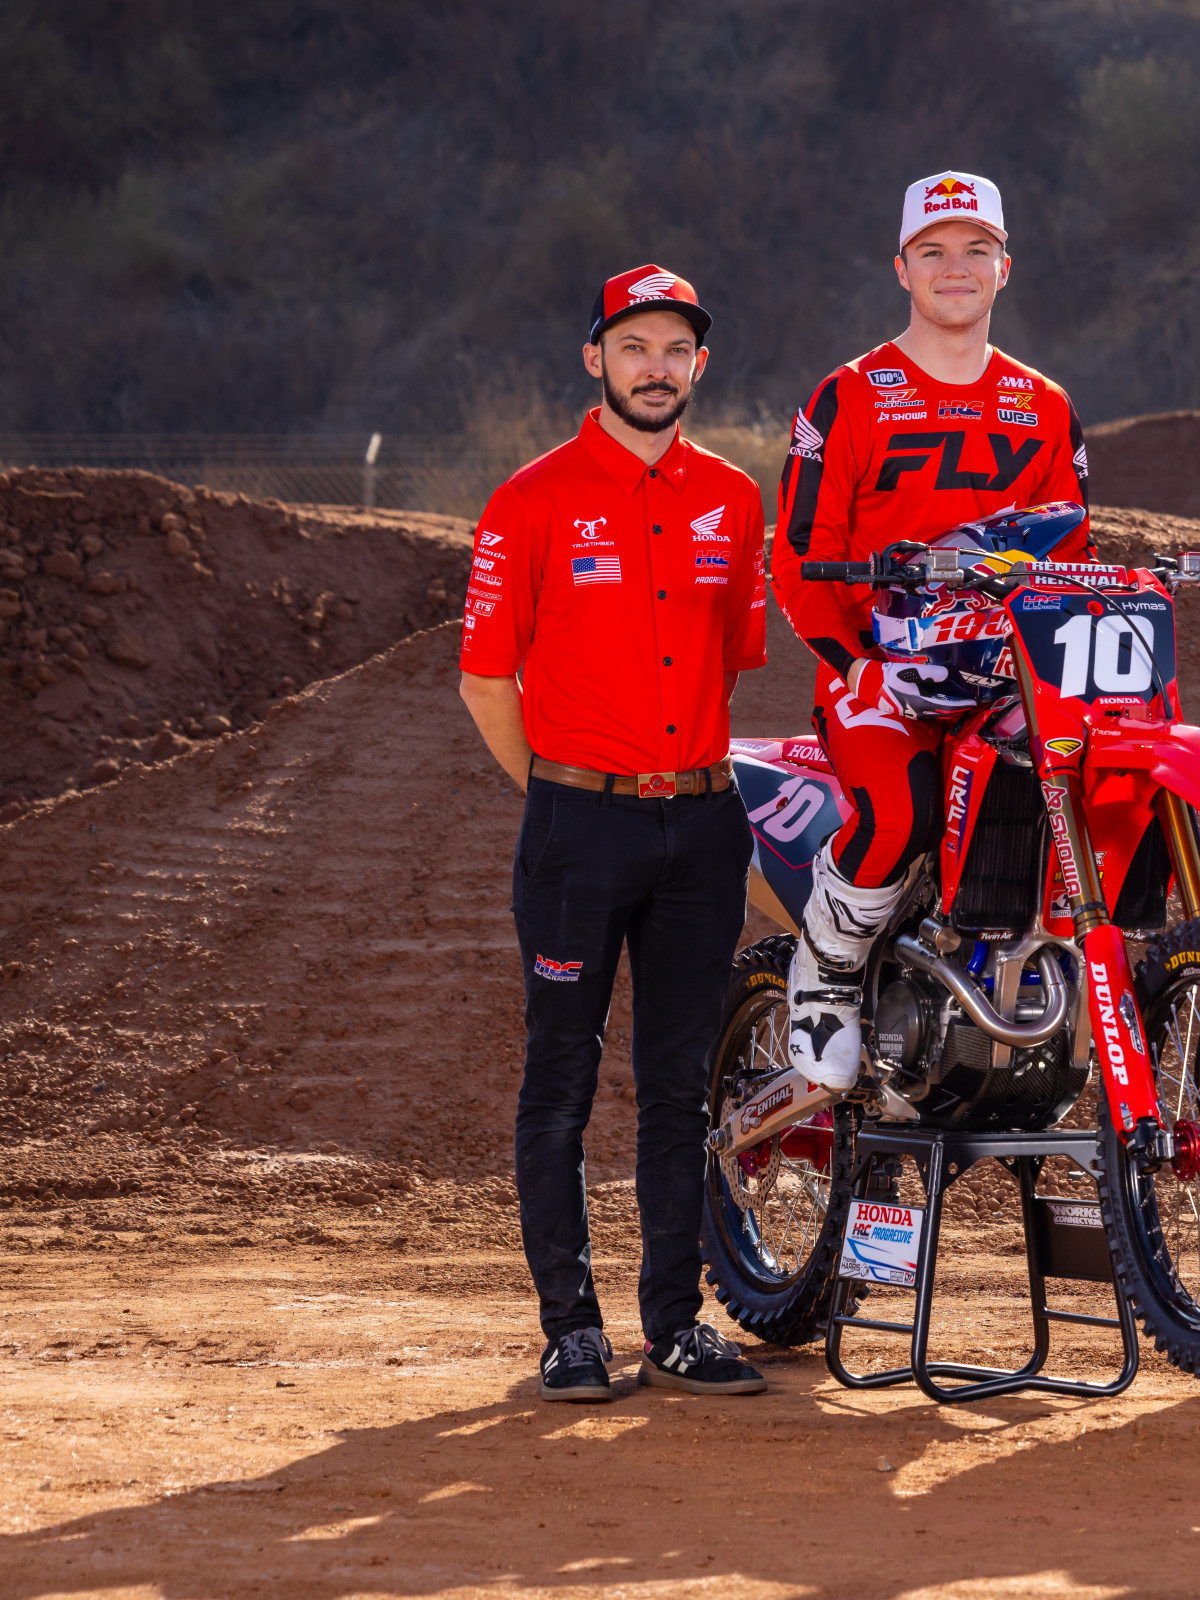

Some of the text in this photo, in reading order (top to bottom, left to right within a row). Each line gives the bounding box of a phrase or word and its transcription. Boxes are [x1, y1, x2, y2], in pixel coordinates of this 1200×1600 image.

[924, 198, 978, 214] Red Bull
[873, 372, 903, 383] 100%
[997, 376, 1034, 390] AMA
[938, 400, 984, 416] HRC
[998, 394, 1033, 410] SMX
[892, 411, 927, 421] SHOWA
[998, 409, 1038, 427] WPS
[788, 446, 824, 463] ONDA
[875, 431, 1046, 491] FLY
[571, 541, 615, 549] TRUETIMBER
[692, 534, 731, 543] HONDA
[695, 550, 731, 565] HRC
[1031, 562, 1119, 573] RENTHAL
[1034, 574, 1121, 587] RENTHAL
[1023, 595, 1061, 608] HRC
[1122, 602, 1166, 612] Hymas
[1054, 615, 1154, 698] 10
[1099, 697, 1141, 705] HONDA
[947, 766, 970, 822] CRF
[748, 776, 825, 842] 10
[1050, 813, 1082, 898] SHOWA
[534, 954, 583, 977] HRC
[1090, 962, 1130, 1086] DUNLOP
[856, 1204, 913, 1227] HONDA
[1050, 1205, 1101, 1218] WORKS
[1055, 1216, 1103, 1226] CONNECTION
[852, 1223, 914, 1244] HRC PROGRESSIVE
